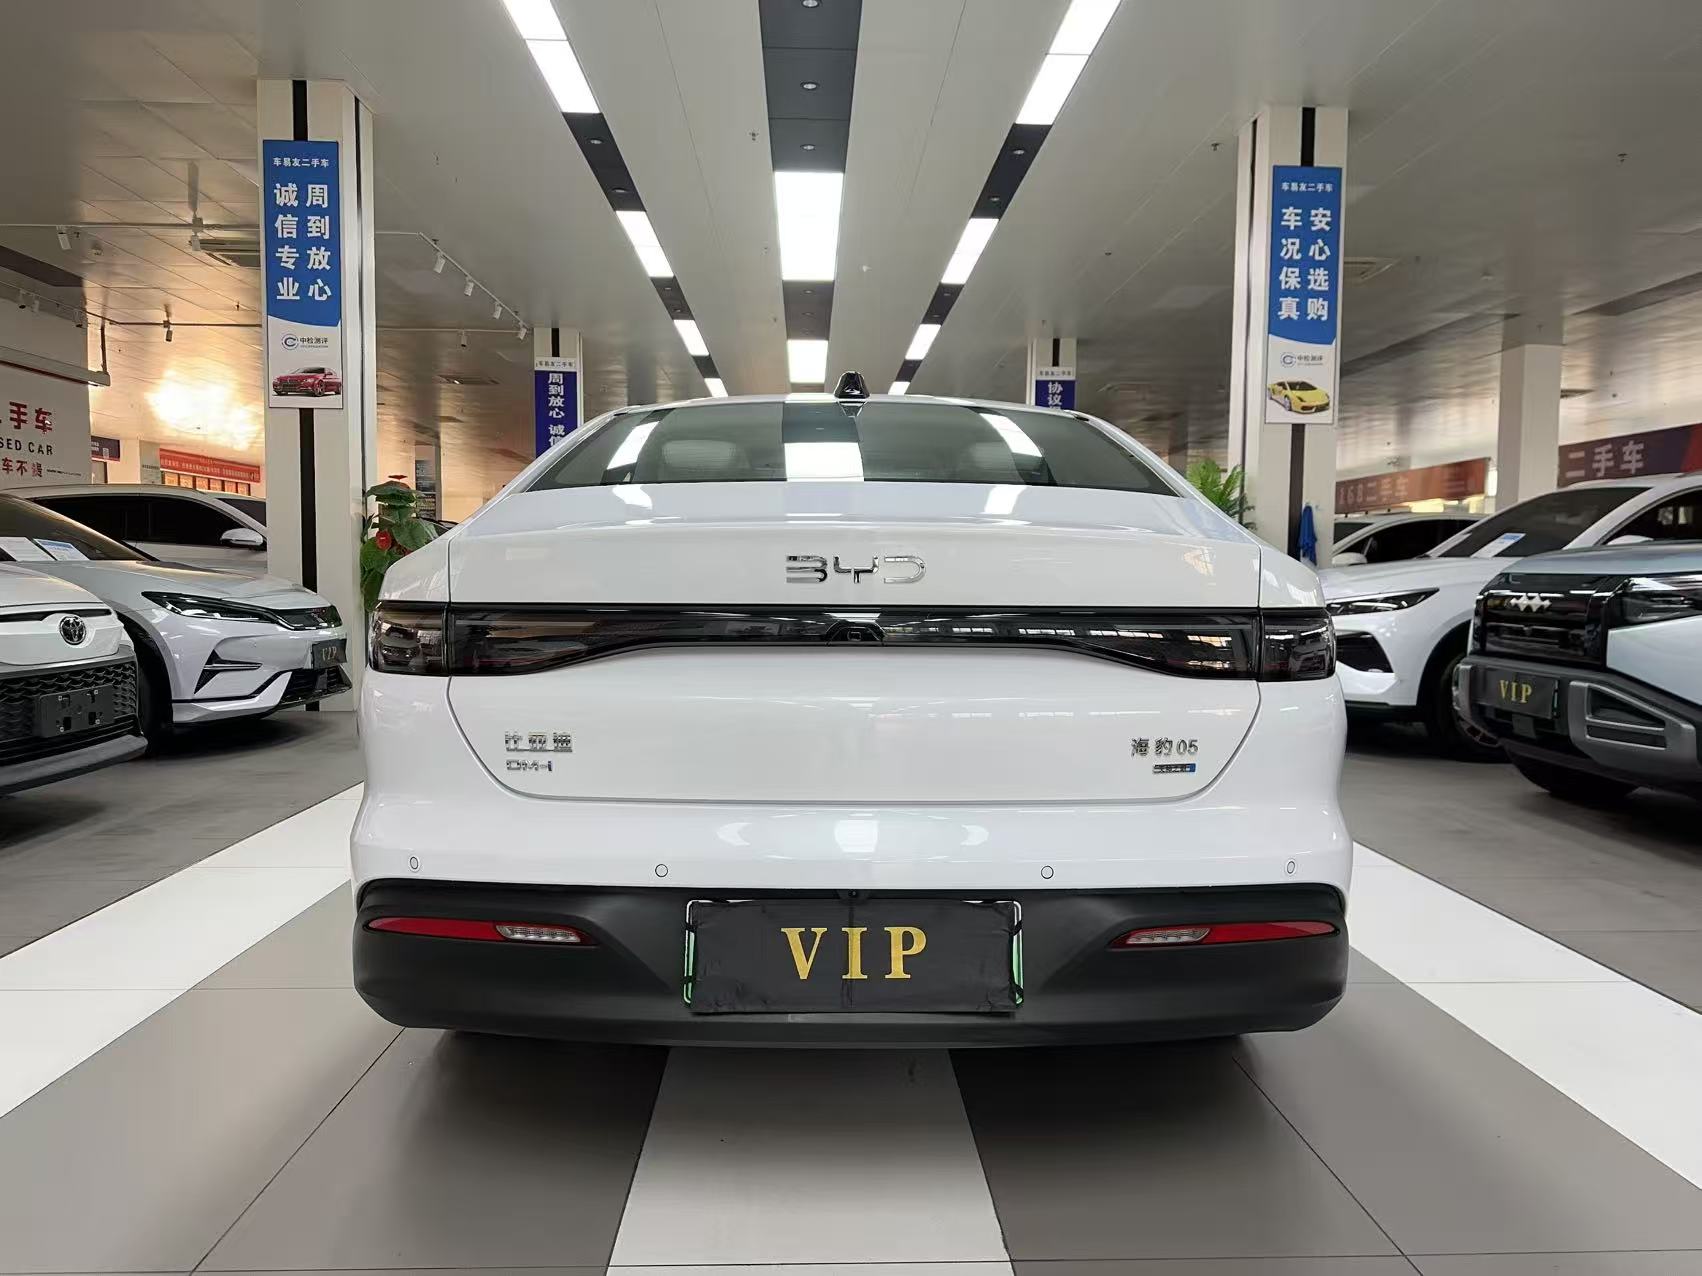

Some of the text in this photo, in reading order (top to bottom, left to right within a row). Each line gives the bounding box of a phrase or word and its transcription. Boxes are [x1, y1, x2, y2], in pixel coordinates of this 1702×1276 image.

[273, 157, 329, 168] 车易友二手车
[274, 182, 300, 301] 诚信专业
[306, 183, 331, 301] 周到放心
[1277, 207, 1303, 320] 车况保真
[1307, 207, 1332, 321] 安心选购
[548, 372, 565, 419] 周到放心
[1047, 382, 1063, 409] 协议
[0, 401, 53, 434] 手车
[28, 441, 53, 456] CAR
[1565, 440, 1645, 478] 二手车
[786, 555, 927, 584] BYD
[1499, 680, 1532, 704] VIP
[780, 926, 928, 980] VIP
